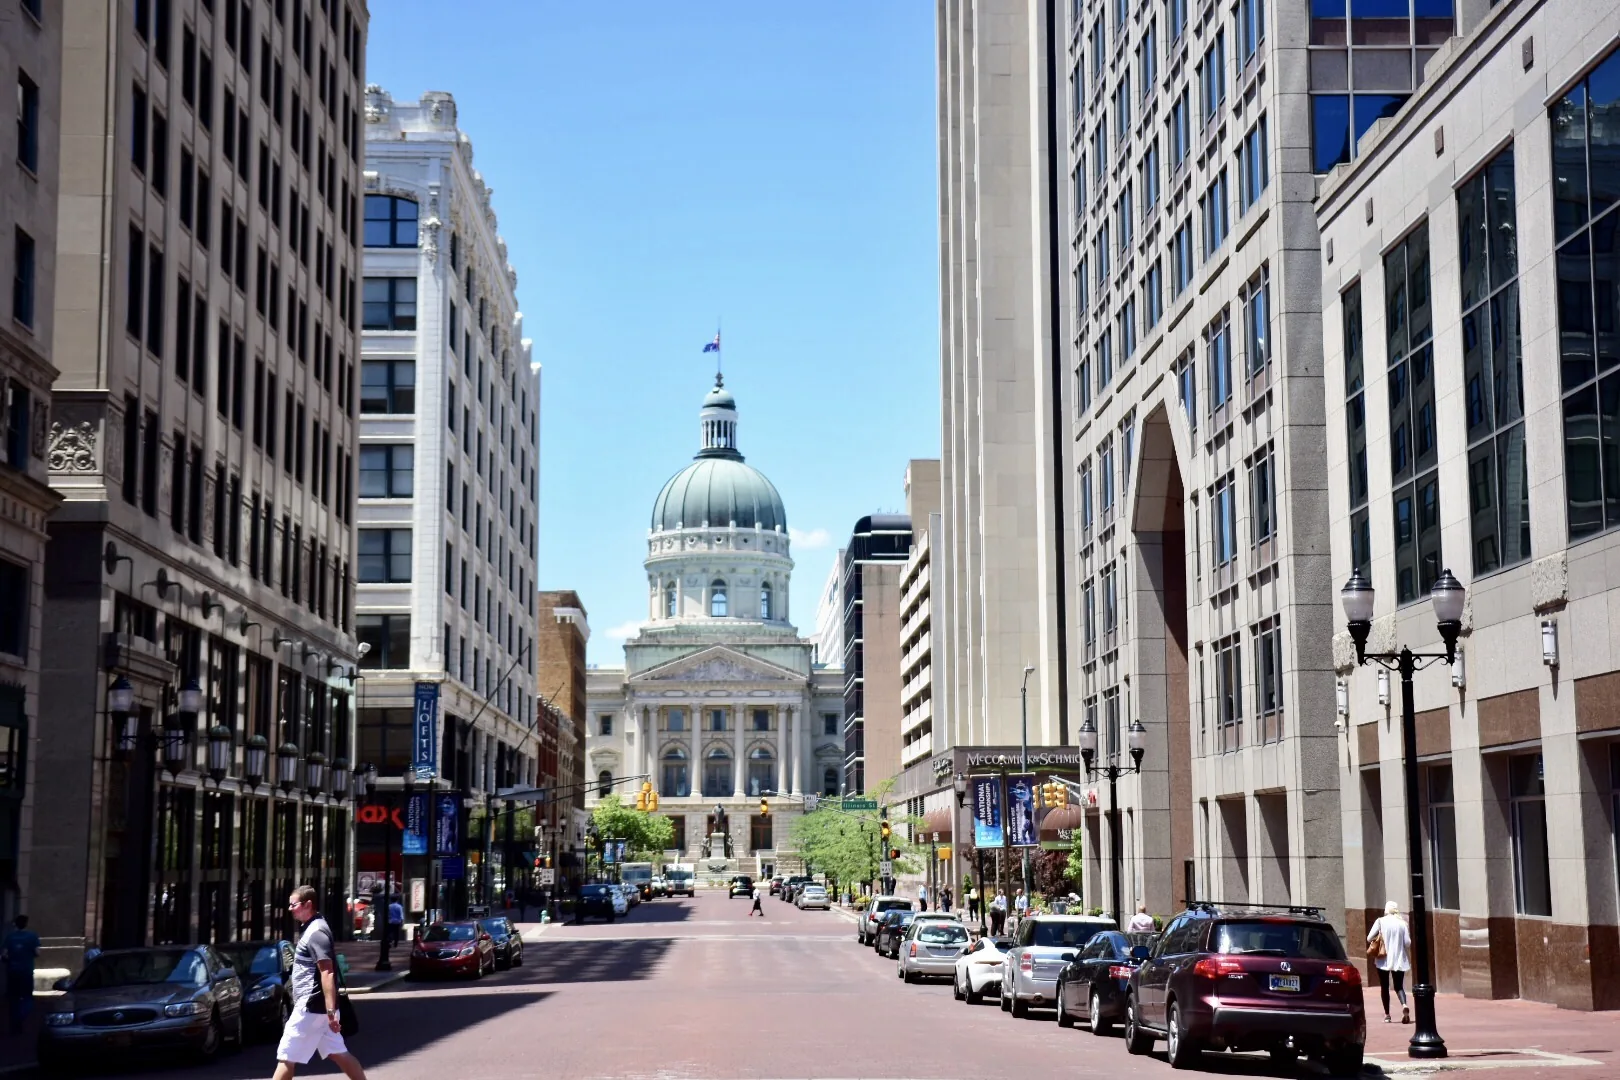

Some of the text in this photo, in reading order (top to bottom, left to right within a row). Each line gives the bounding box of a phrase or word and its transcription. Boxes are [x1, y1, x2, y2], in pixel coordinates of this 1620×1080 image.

[420, 701, 430, 761] LOFTS
[978, 783, 986, 818] NATIONAL
[985, 782, 993, 826] CHAMPIONSHIPS
